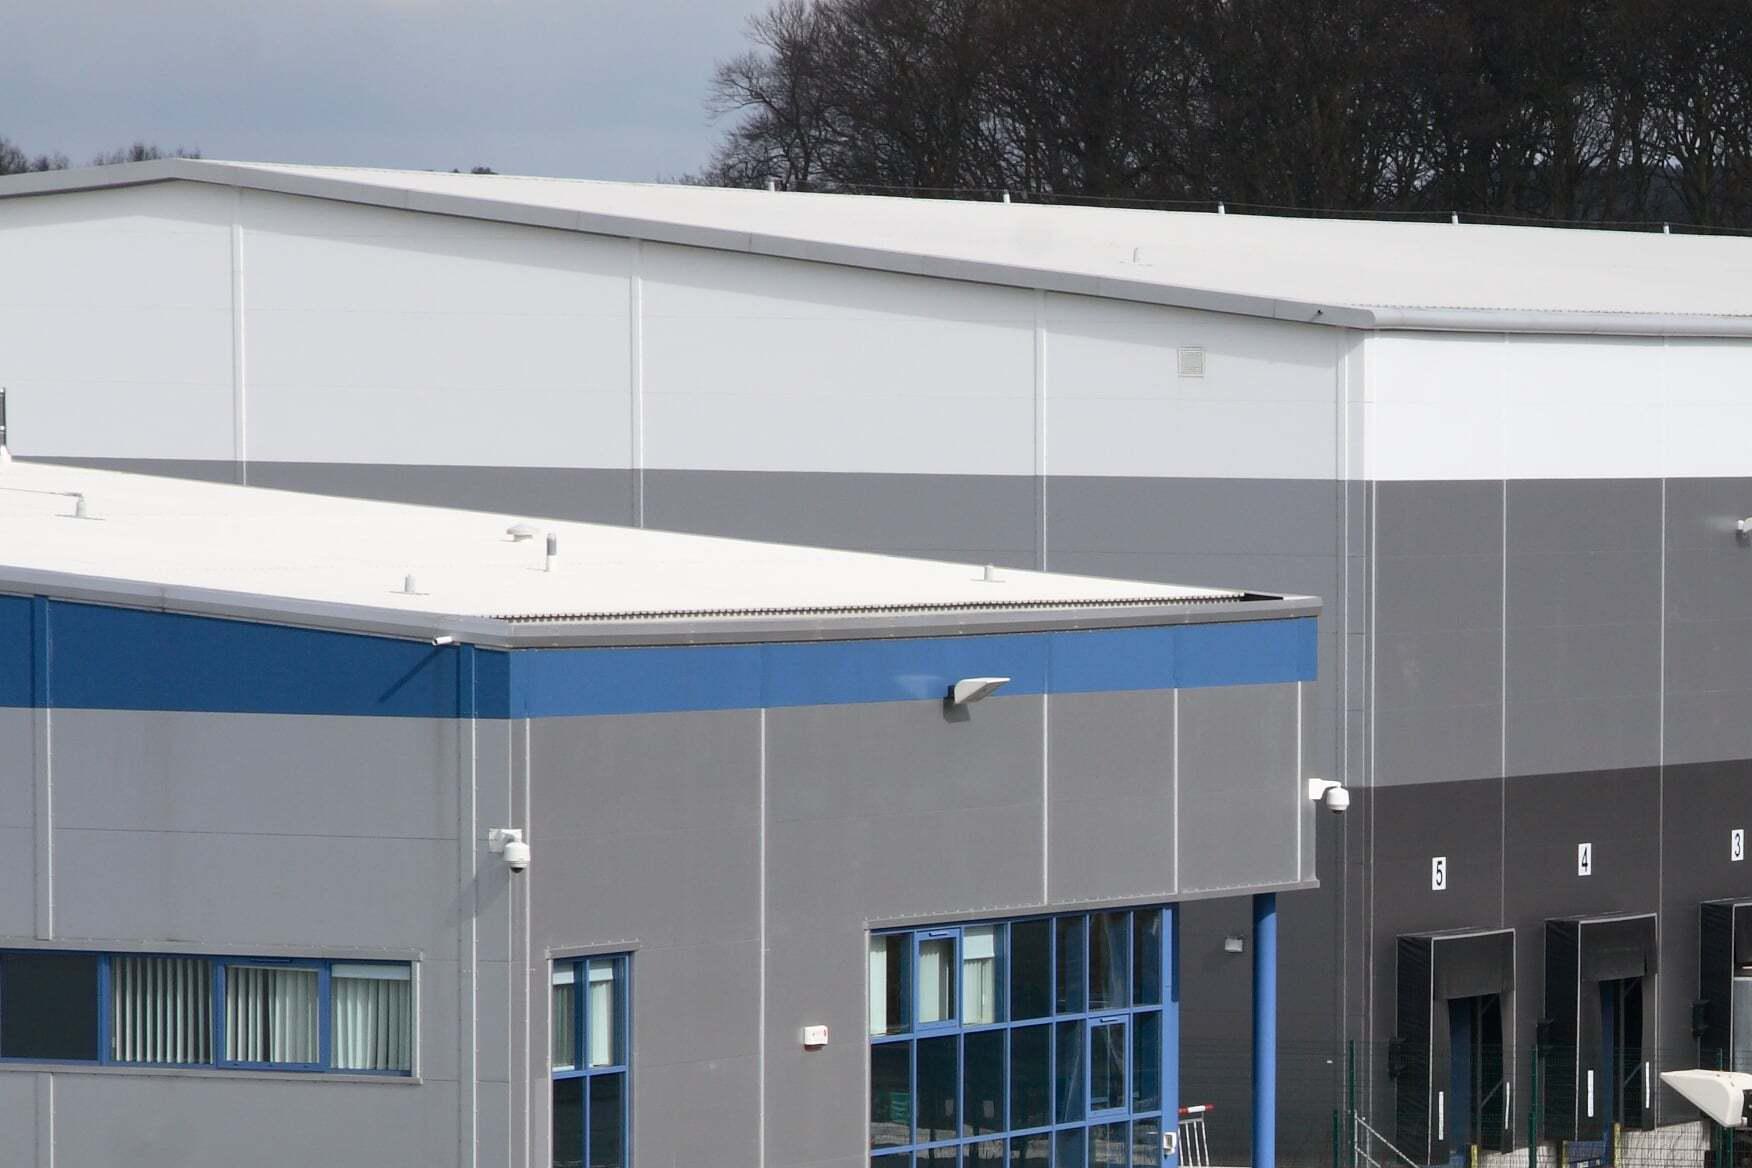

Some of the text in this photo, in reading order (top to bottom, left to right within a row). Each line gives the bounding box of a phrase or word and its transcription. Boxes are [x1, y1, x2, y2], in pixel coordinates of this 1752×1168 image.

[1734, 832, 1741, 857] 3
[1581, 846, 1589, 872] 4
[1436, 860, 1443, 887] 5
